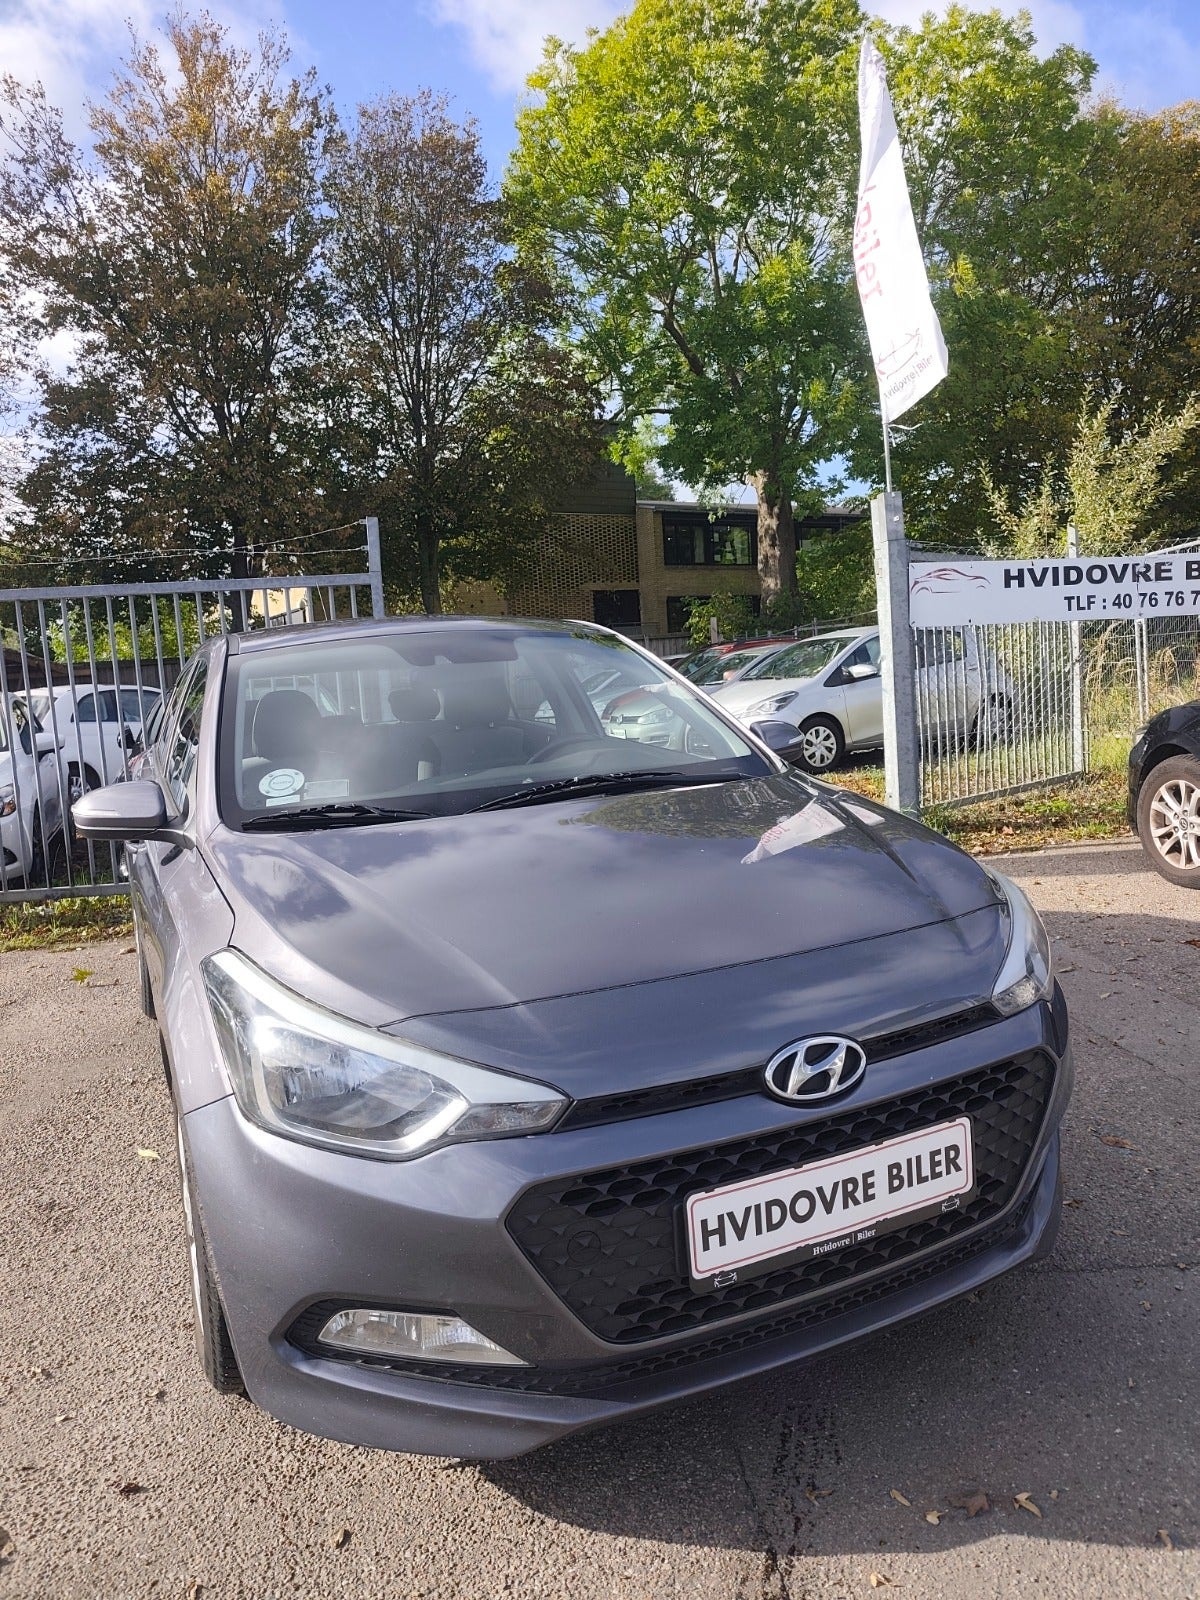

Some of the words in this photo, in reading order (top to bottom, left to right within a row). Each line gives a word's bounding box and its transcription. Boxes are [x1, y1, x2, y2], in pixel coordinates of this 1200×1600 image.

[1003, 560, 1173, 589] HVIDOVRE
[1064, 594, 1097, 612] TLF
[1112, 593, 1132, 609] 40
[1138, 591, 1158, 608] 76
[1165, 590, 1185, 606] 76
[700, 1170, 876, 1252] HVIDOVRE
[887, 1143, 962, 1195] BILER
[813, 1237, 850, 1256] Hvidovre
[857, 1229, 876, 1241] Biler
